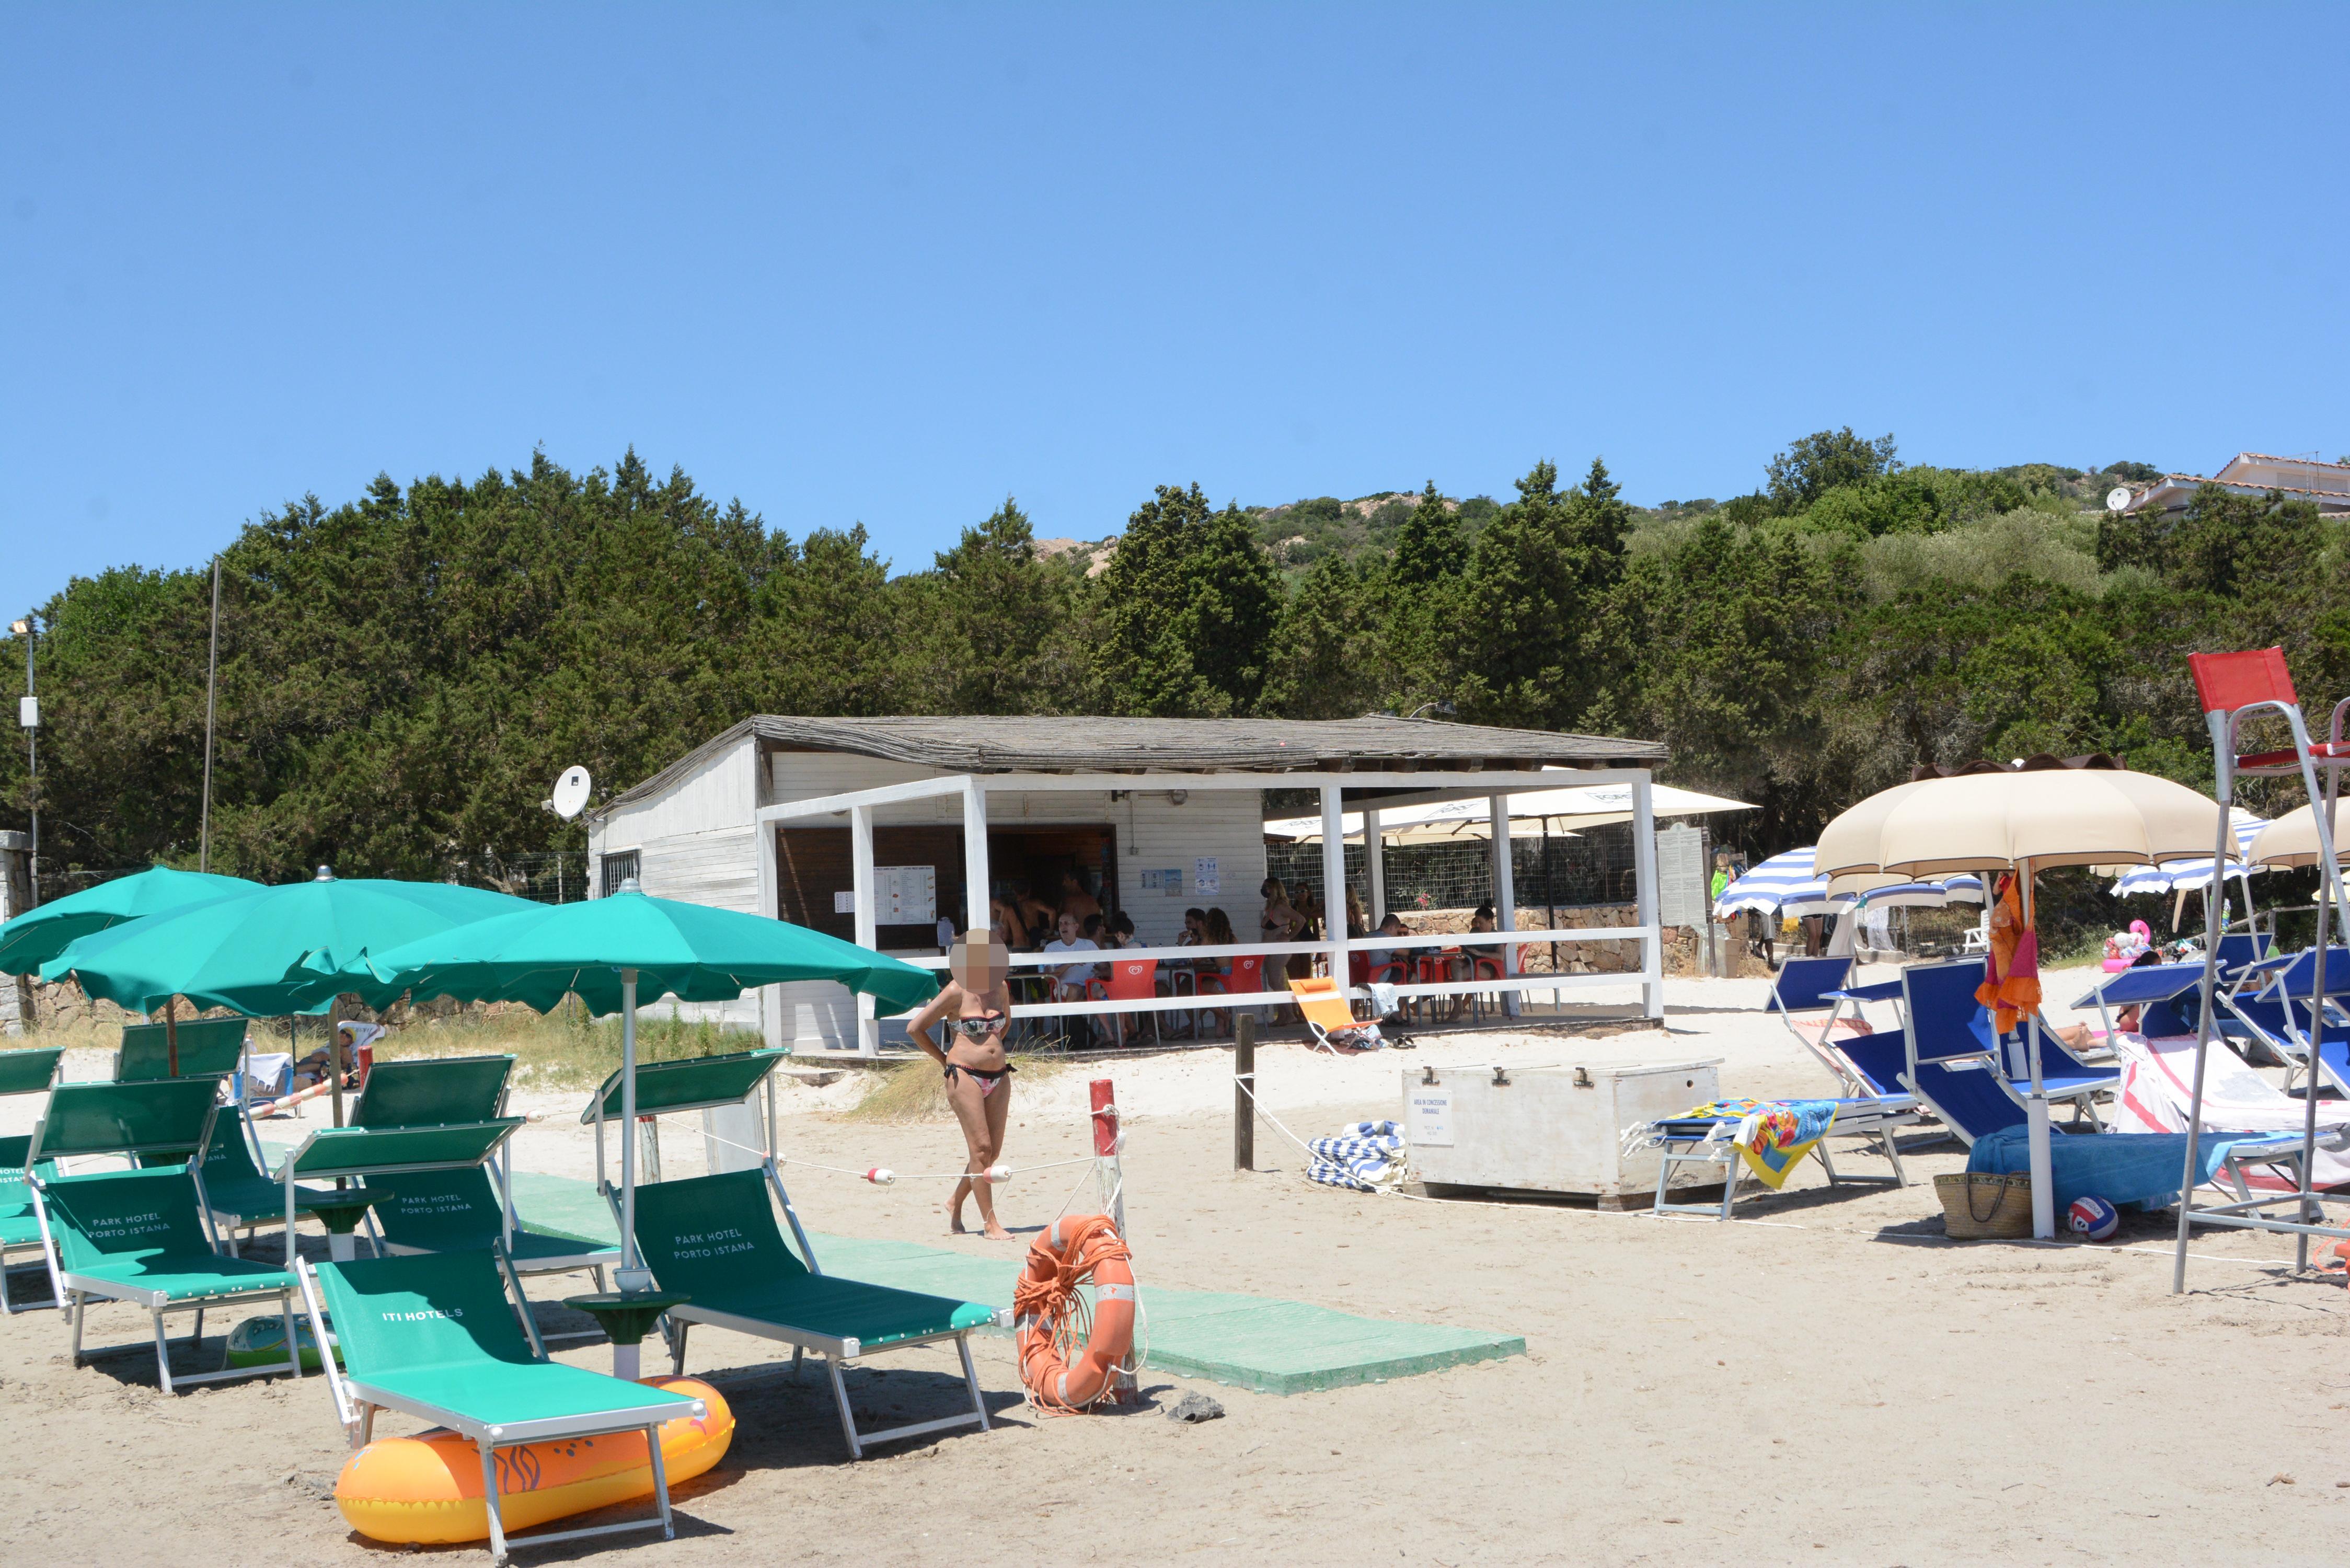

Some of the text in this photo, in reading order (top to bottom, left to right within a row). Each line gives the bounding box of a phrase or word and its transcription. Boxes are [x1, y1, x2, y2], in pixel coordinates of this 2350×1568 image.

[436, 1203, 471, 1213] ISTANA
[93, 1213, 161, 1226] PARK HOTEL
[89, 1223, 170, 1238] PORTO ISTANA
[675, 1228, 742, 1244] PARK HOTEL
[674, 1242, 755, 1259] PORTO ISTANA
[382, 1308, 464, 1321] ITI HOTELS
